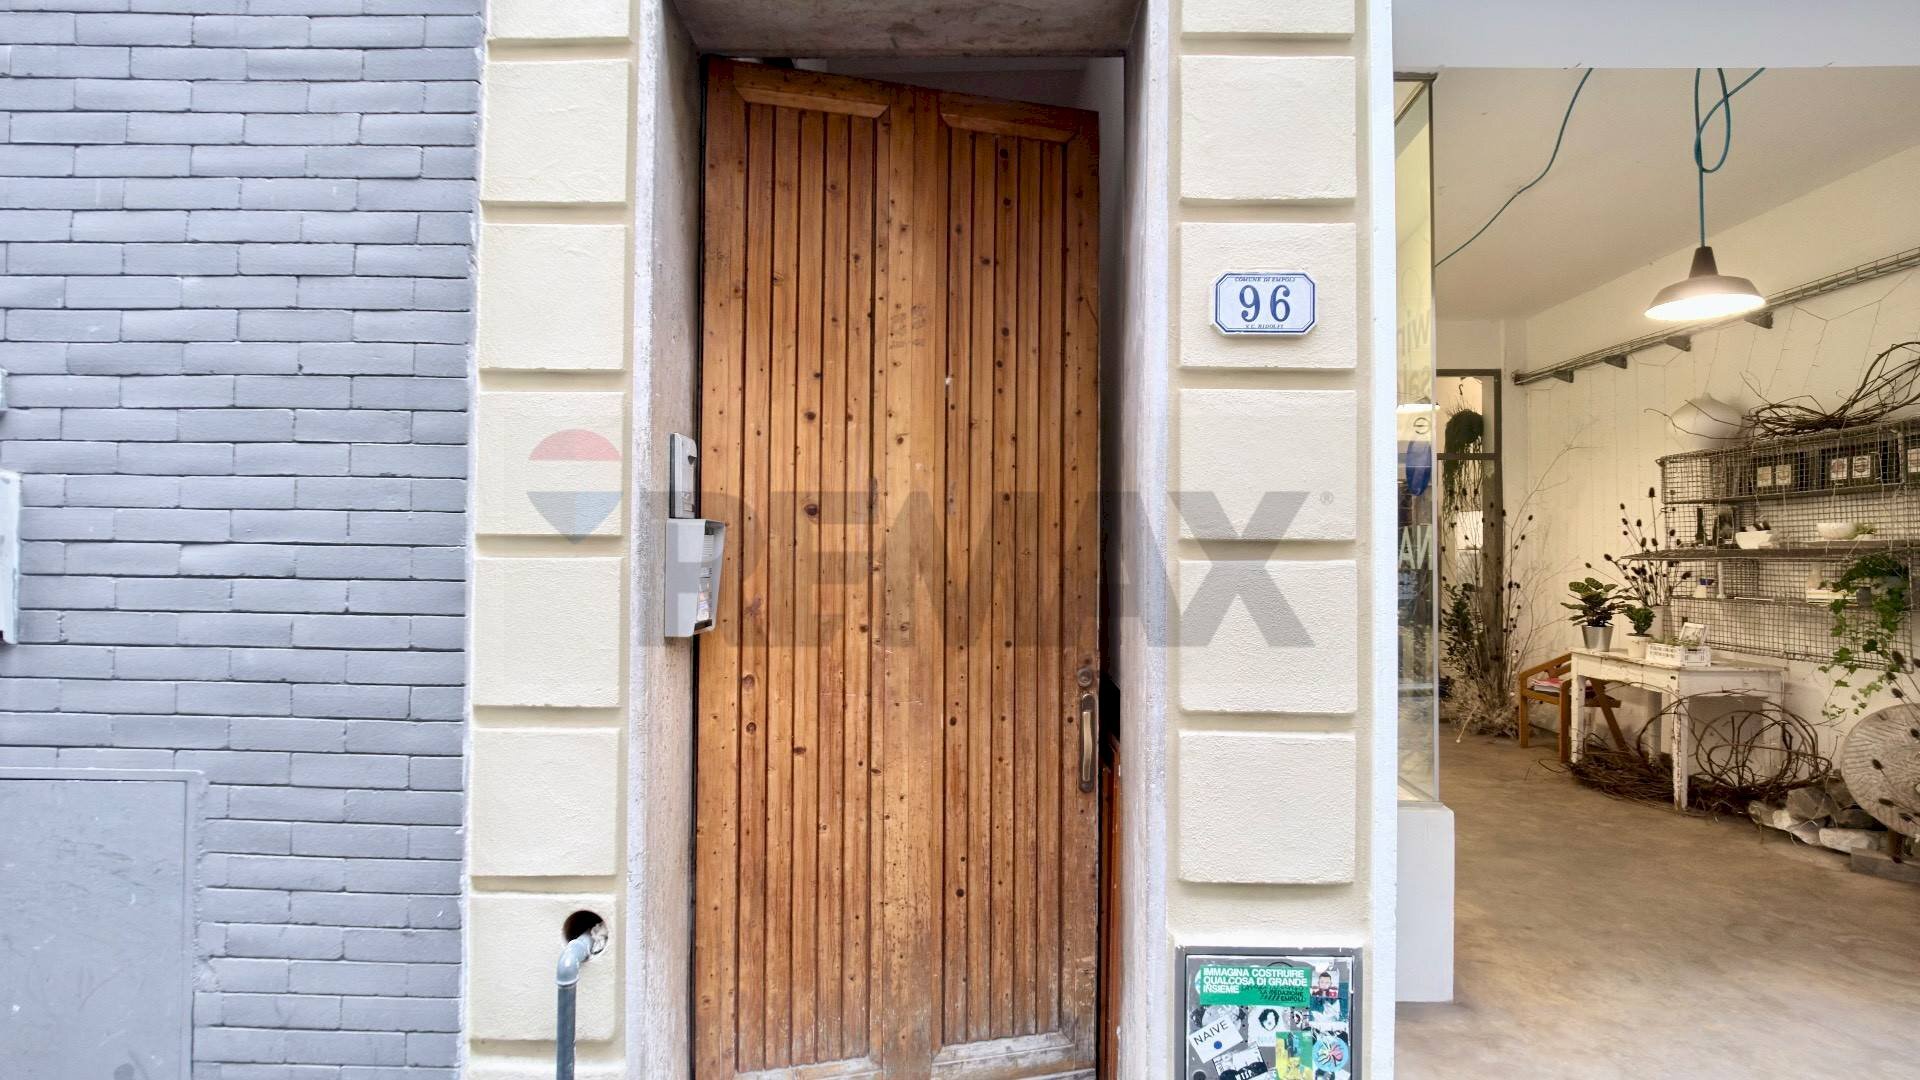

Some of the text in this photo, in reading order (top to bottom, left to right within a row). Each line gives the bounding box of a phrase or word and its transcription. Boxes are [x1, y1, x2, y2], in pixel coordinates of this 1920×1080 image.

[1238, 285, 1291, 323] 96
[1203, 967, 1305, 978] IMMAGINA COSTRUIRE
[1203, 976, 1308, 987] QUALCOSA DI GRANDE
[1202, 984, 1240, 994] INSIEME
[1193, 1019, 1229, 1046] NAIVE
